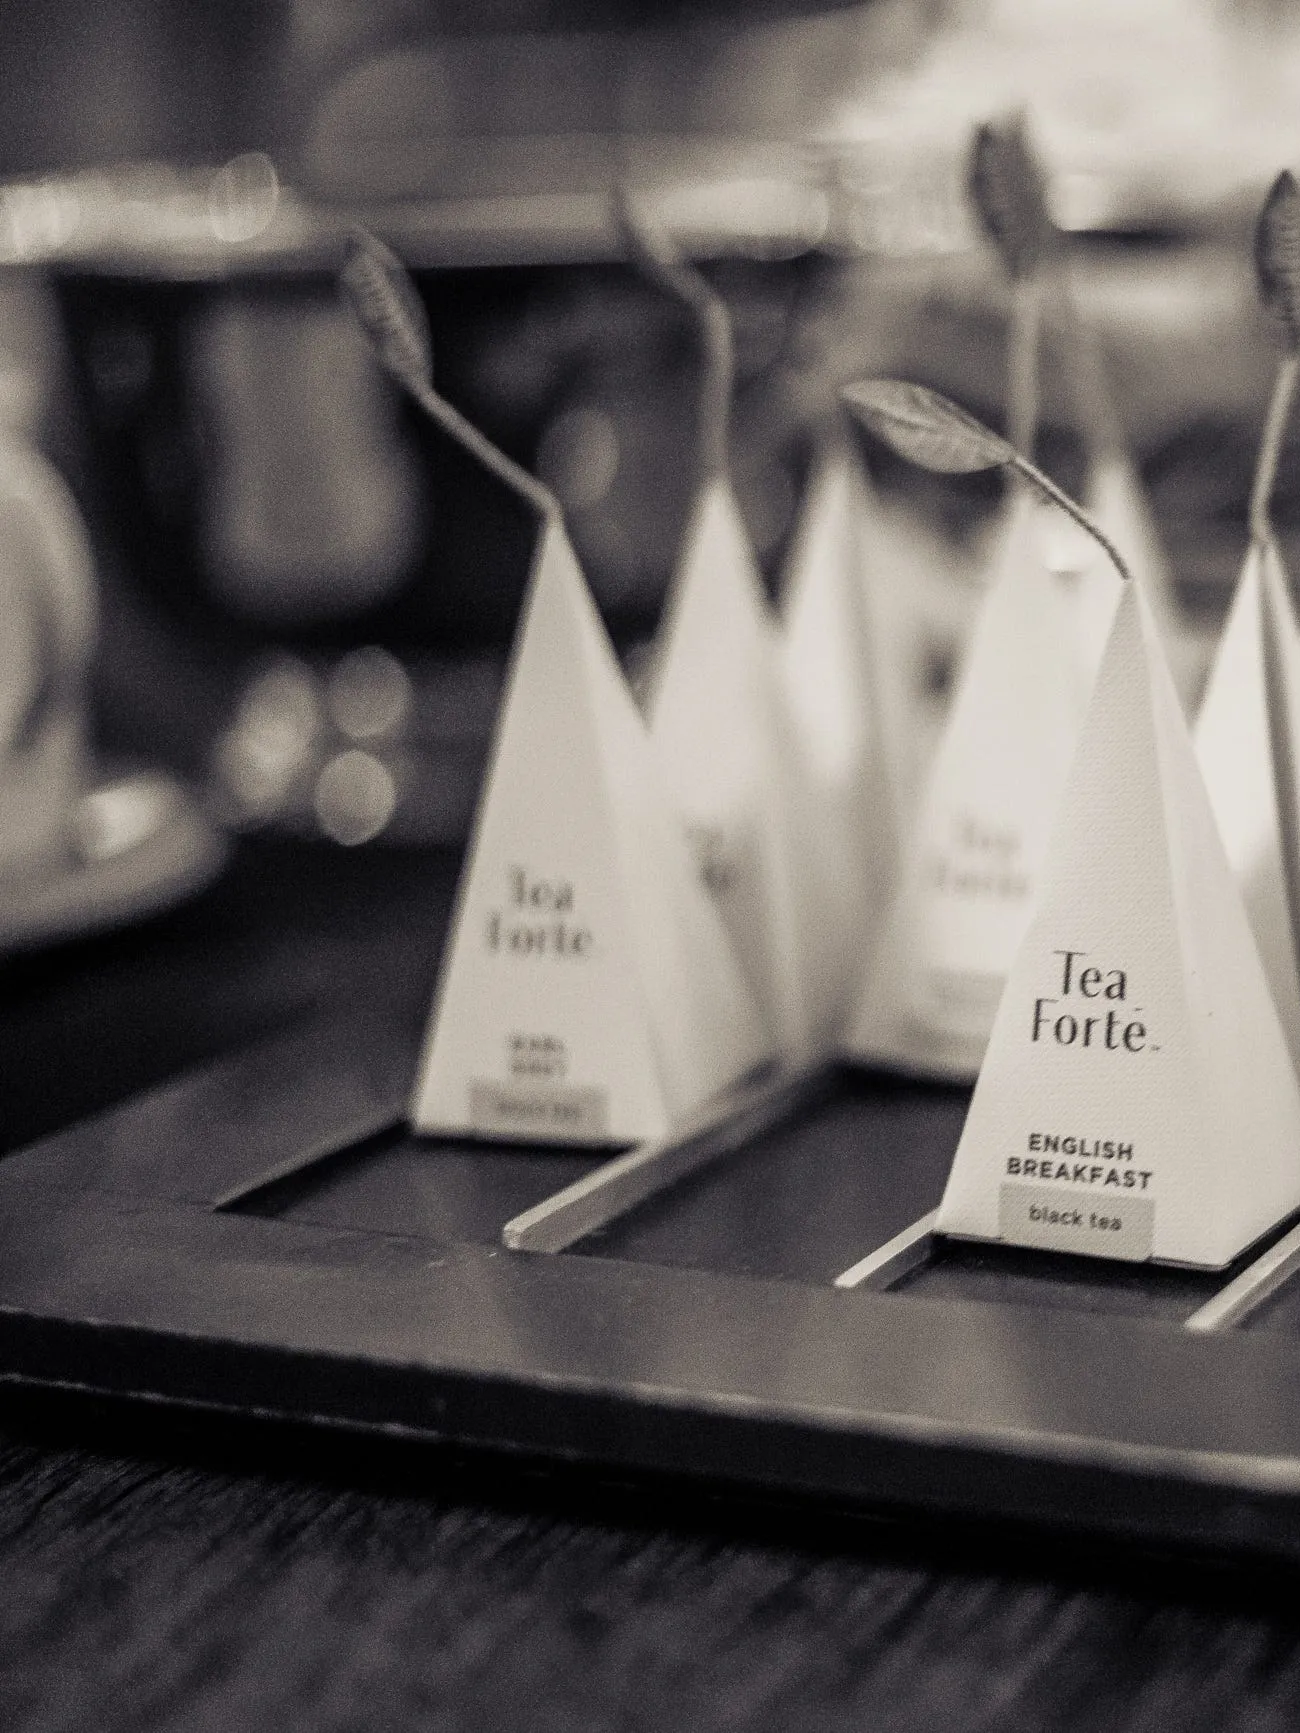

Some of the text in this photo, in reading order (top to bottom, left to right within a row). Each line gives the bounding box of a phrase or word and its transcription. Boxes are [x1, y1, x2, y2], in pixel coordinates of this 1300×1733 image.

[1053, 950, 1128, 1001] Tea
[1027, 1132, 1133, 1161] ENGLISH
[1006, 1156, 1152, 1190] BREAKFAST
[1028, 1204, 1122, 1232] black tea
